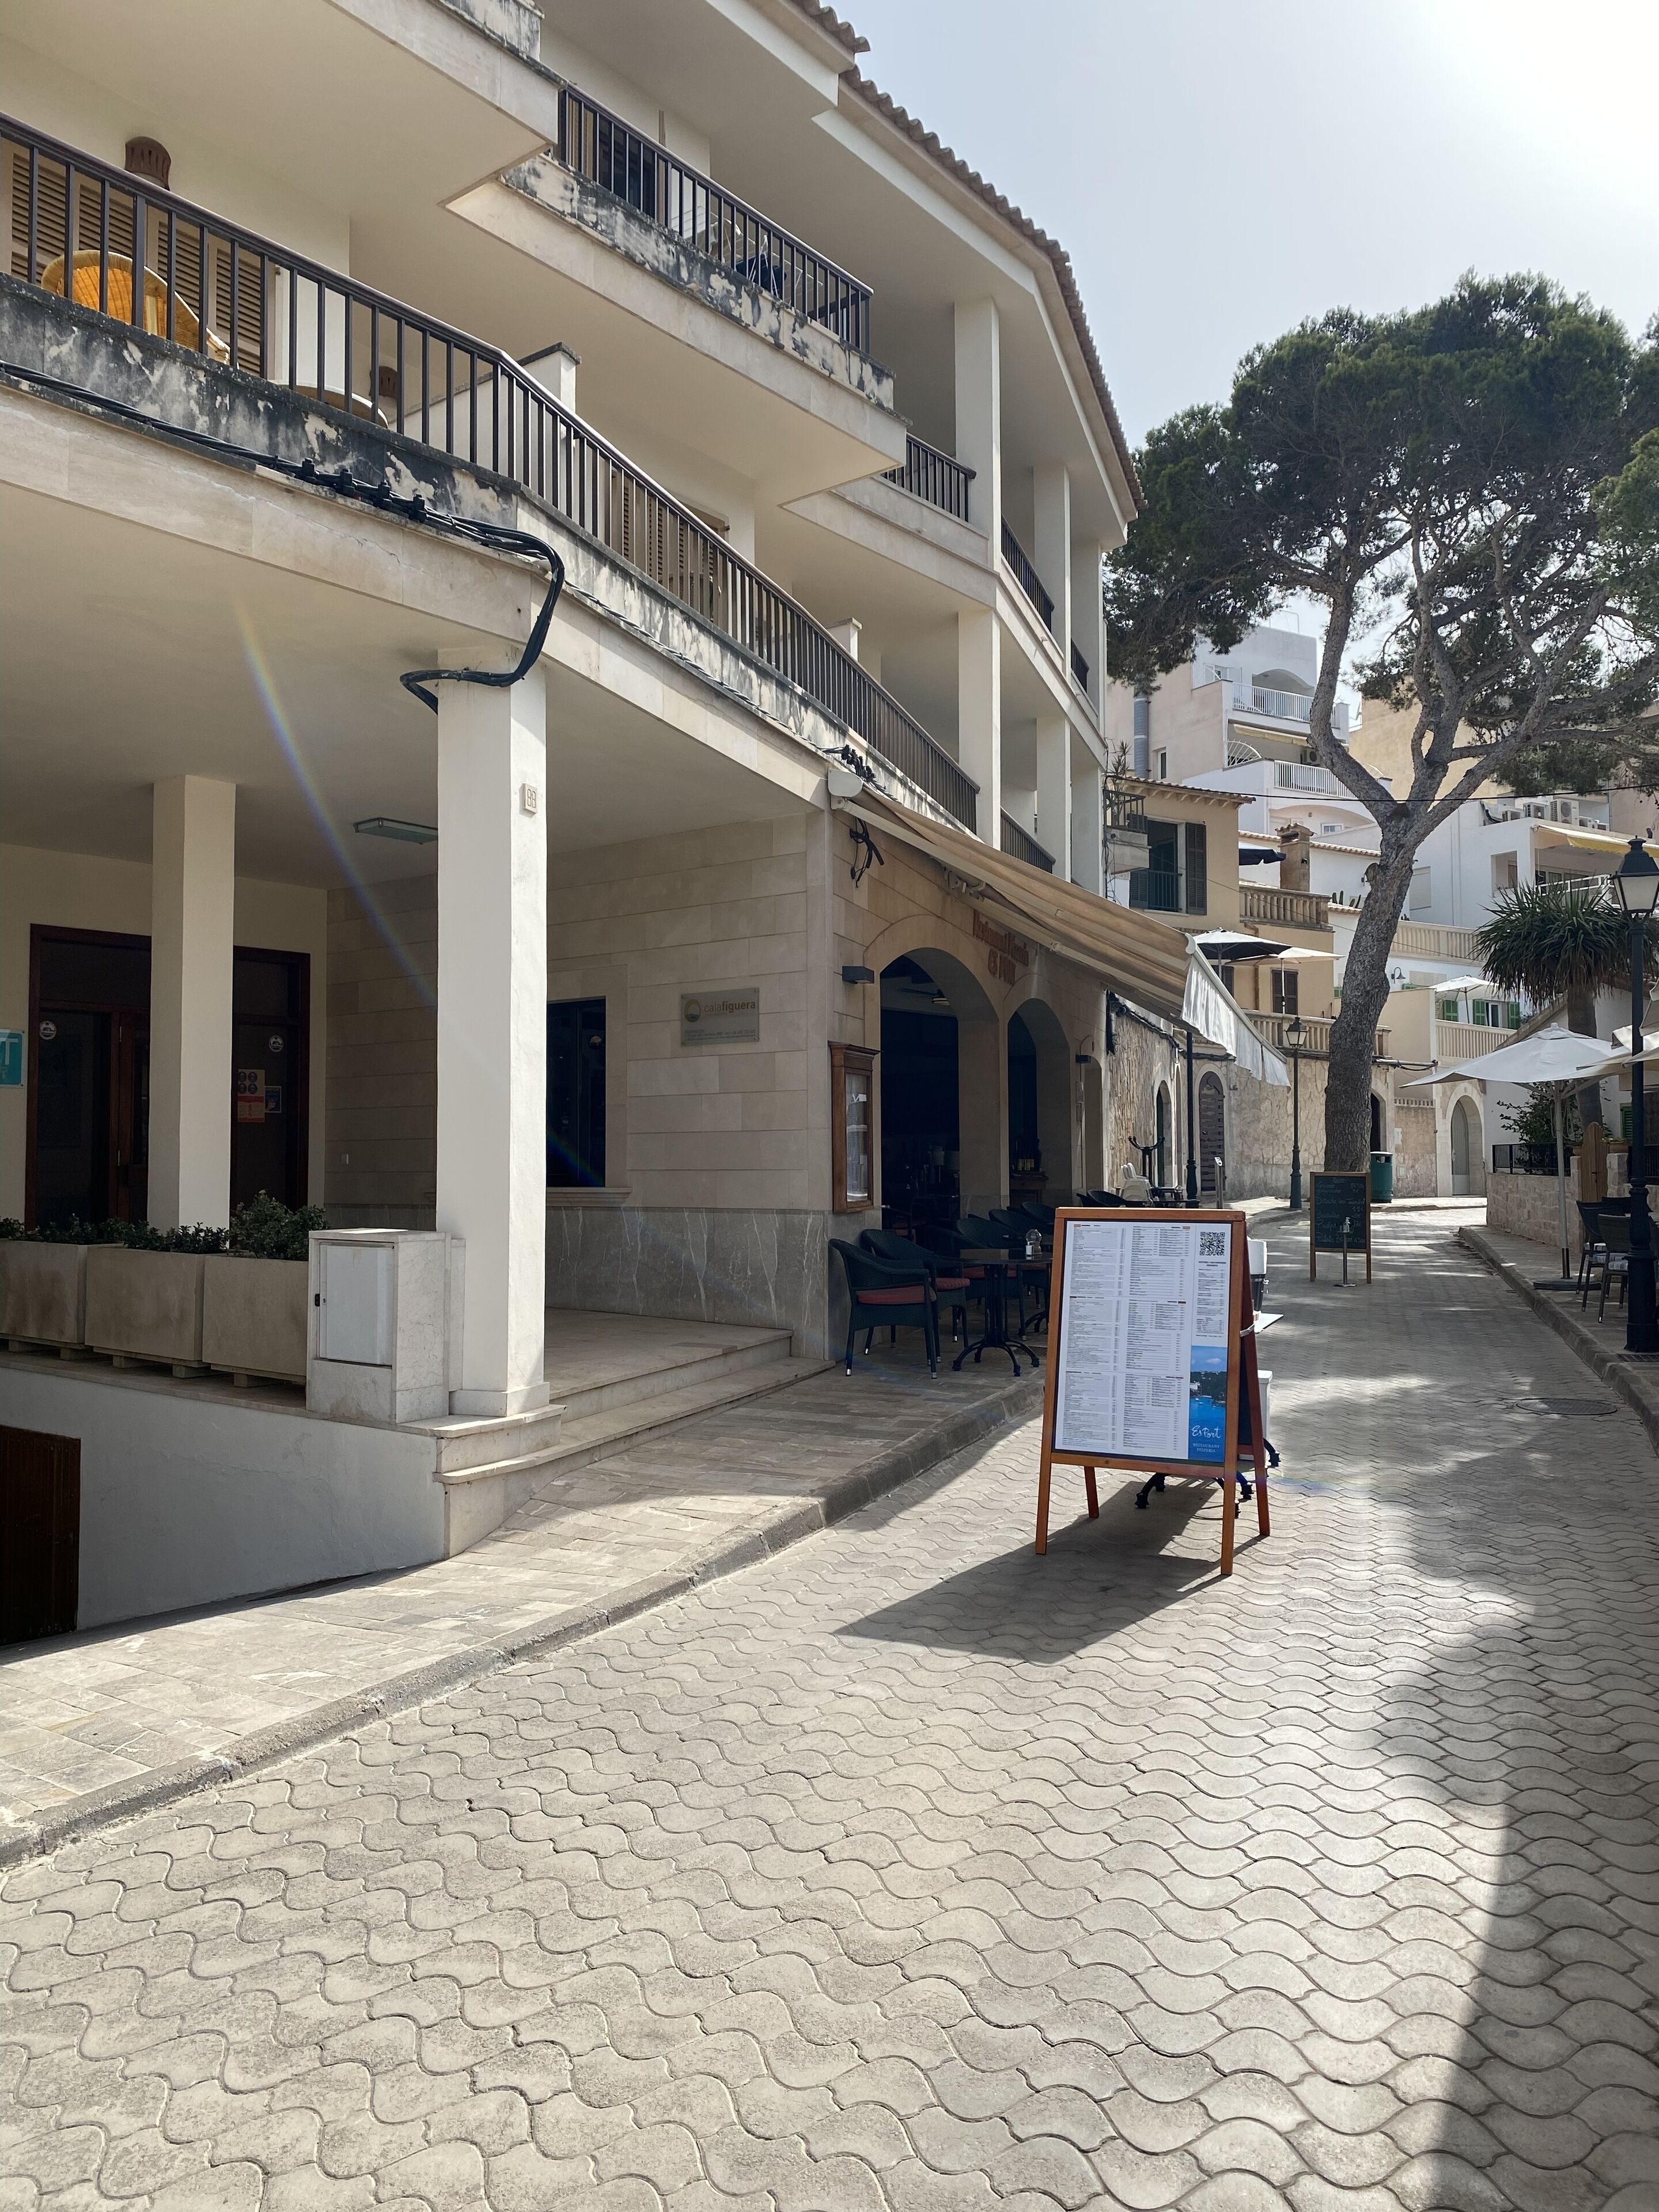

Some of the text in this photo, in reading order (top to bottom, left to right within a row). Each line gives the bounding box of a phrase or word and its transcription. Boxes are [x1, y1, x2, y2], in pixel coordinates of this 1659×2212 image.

[704, 1001, 756, 1013] calafiguera
[1191, 1425, 1222, 1438] Es Port
